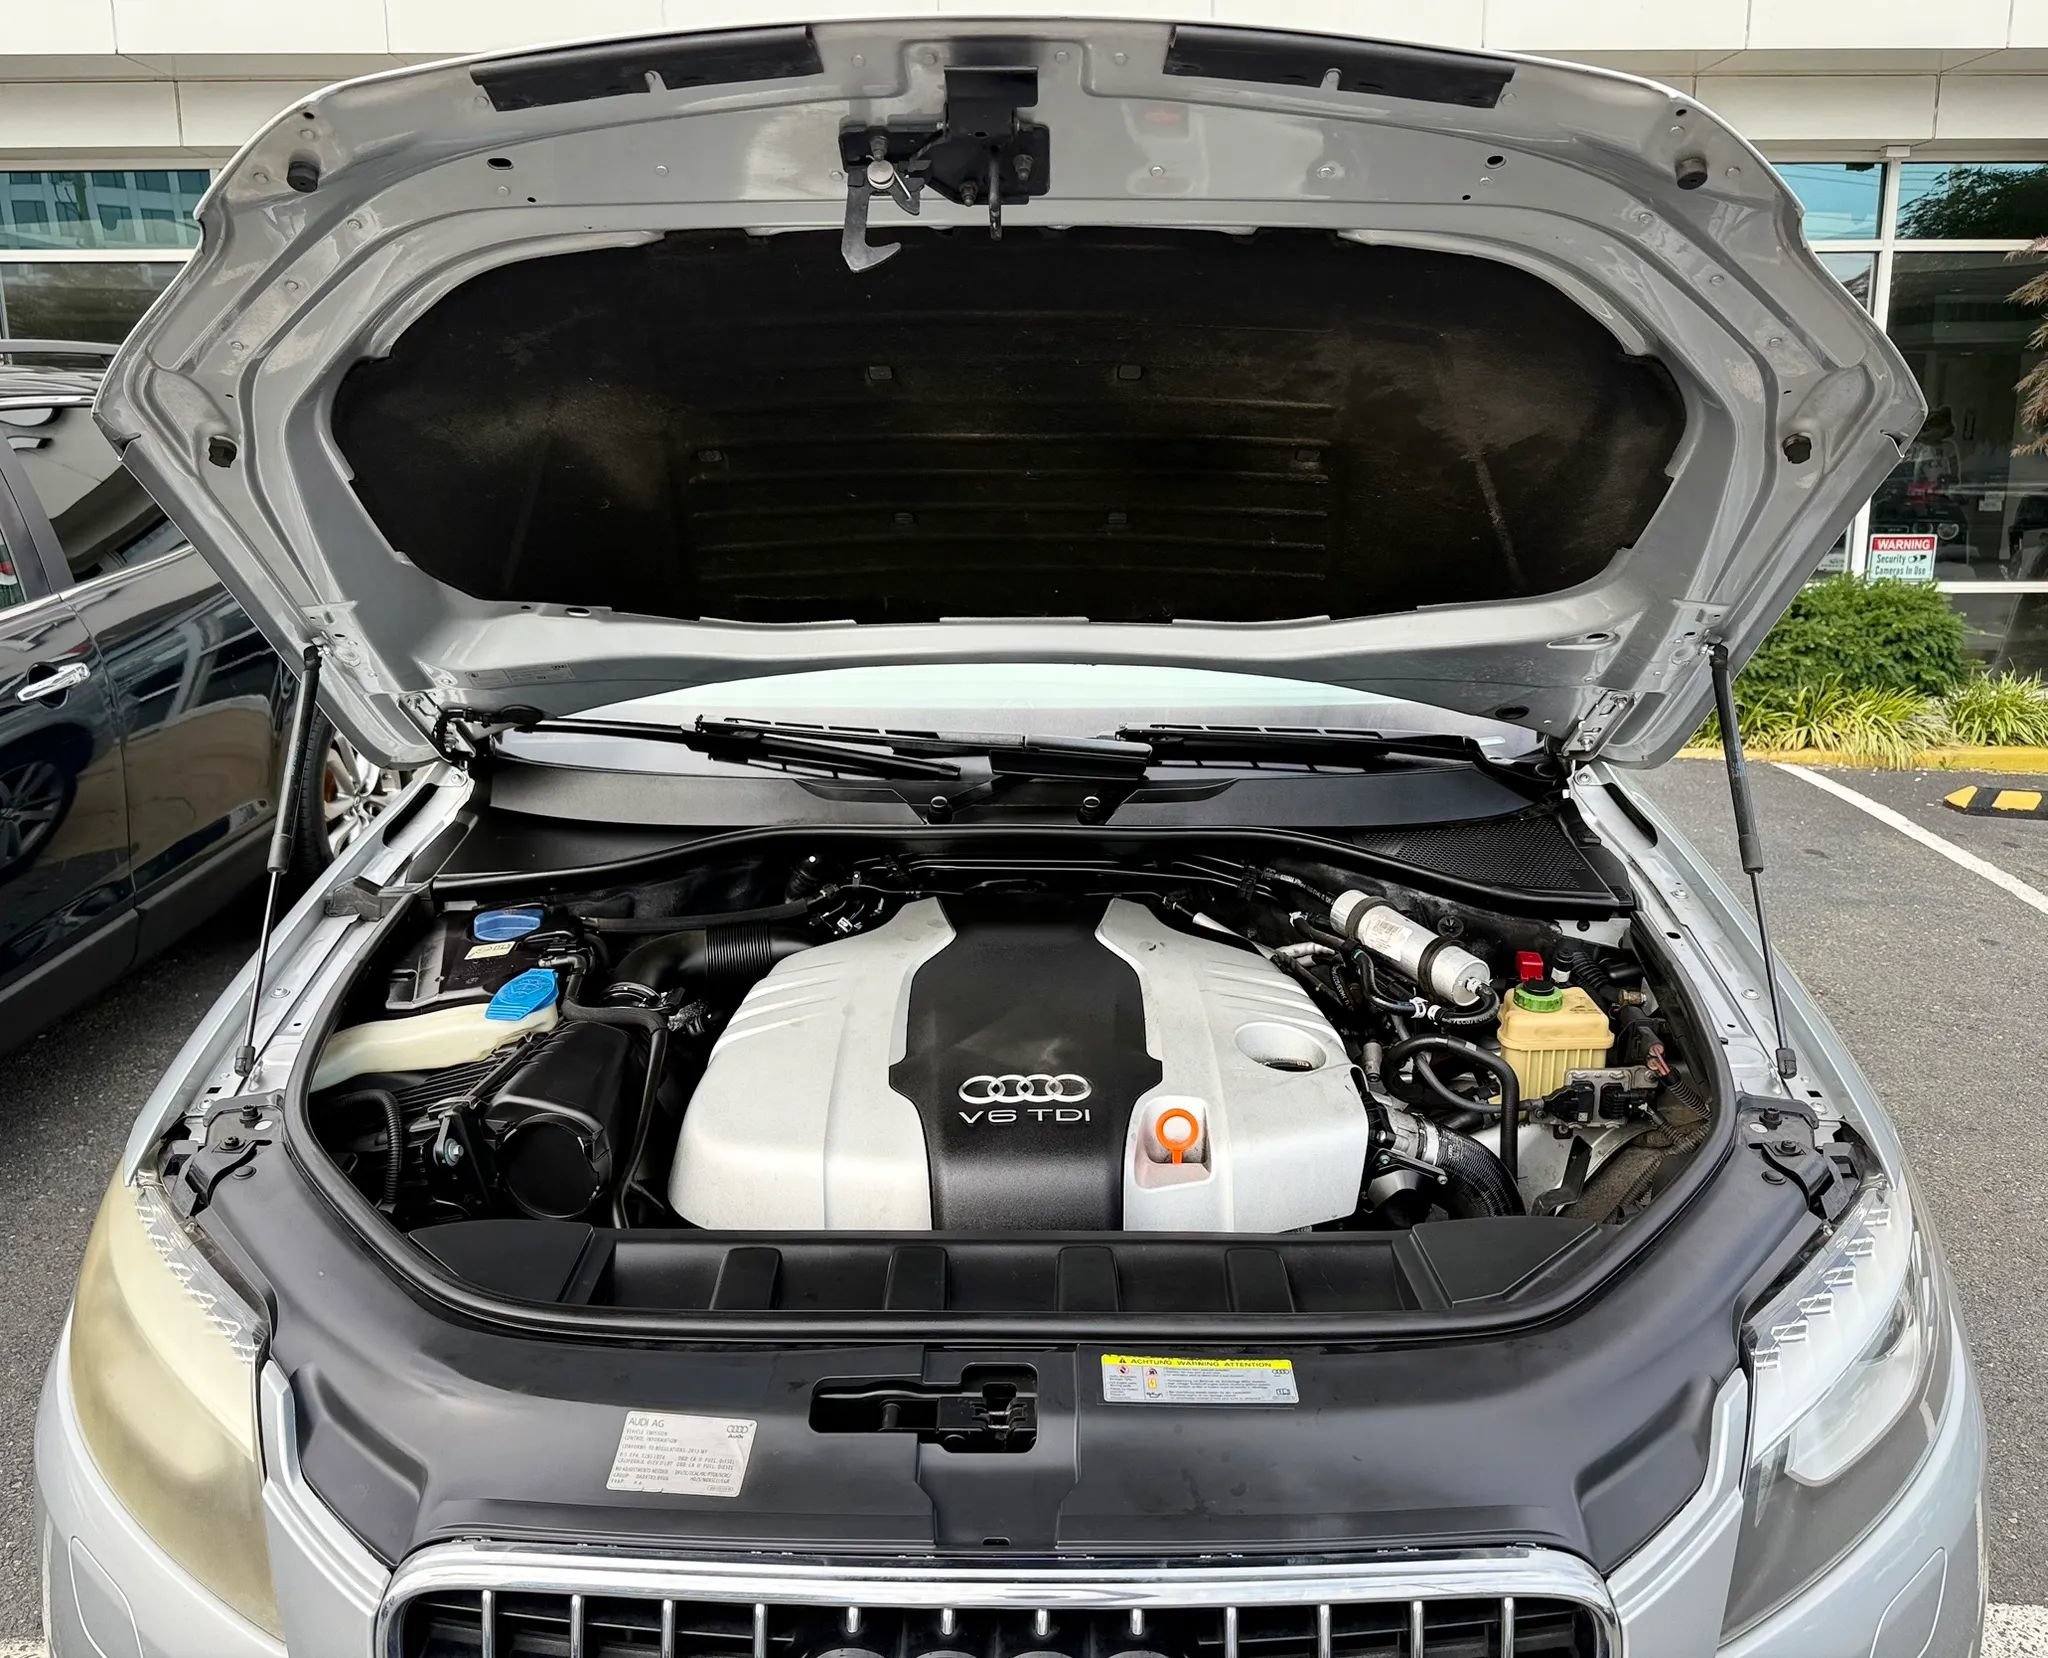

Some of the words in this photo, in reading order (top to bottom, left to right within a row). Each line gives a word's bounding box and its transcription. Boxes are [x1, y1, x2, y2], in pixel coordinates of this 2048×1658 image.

[1878, 539, 1930, 550] WARNING
[1876, 554, 1906, 565] Security
[1875, 566, 1904, 576] Cameras
[1905, 566, 1913, 575] In
[1914, 566, 1926, 575] Use
[958, 1109, 1017, 1124] V6
[1027, 1108, 1091, 1122] TDI
[1130, 1357, 1173, 1366] ACHTUNG
[1176, 1359, 1220, 1367] WARNING
[1223, 1360, 1272, 1368] ATTENTION
[628, 1417, 650, 1427] AUDI
[651, 1419, 665, 1428] AG
